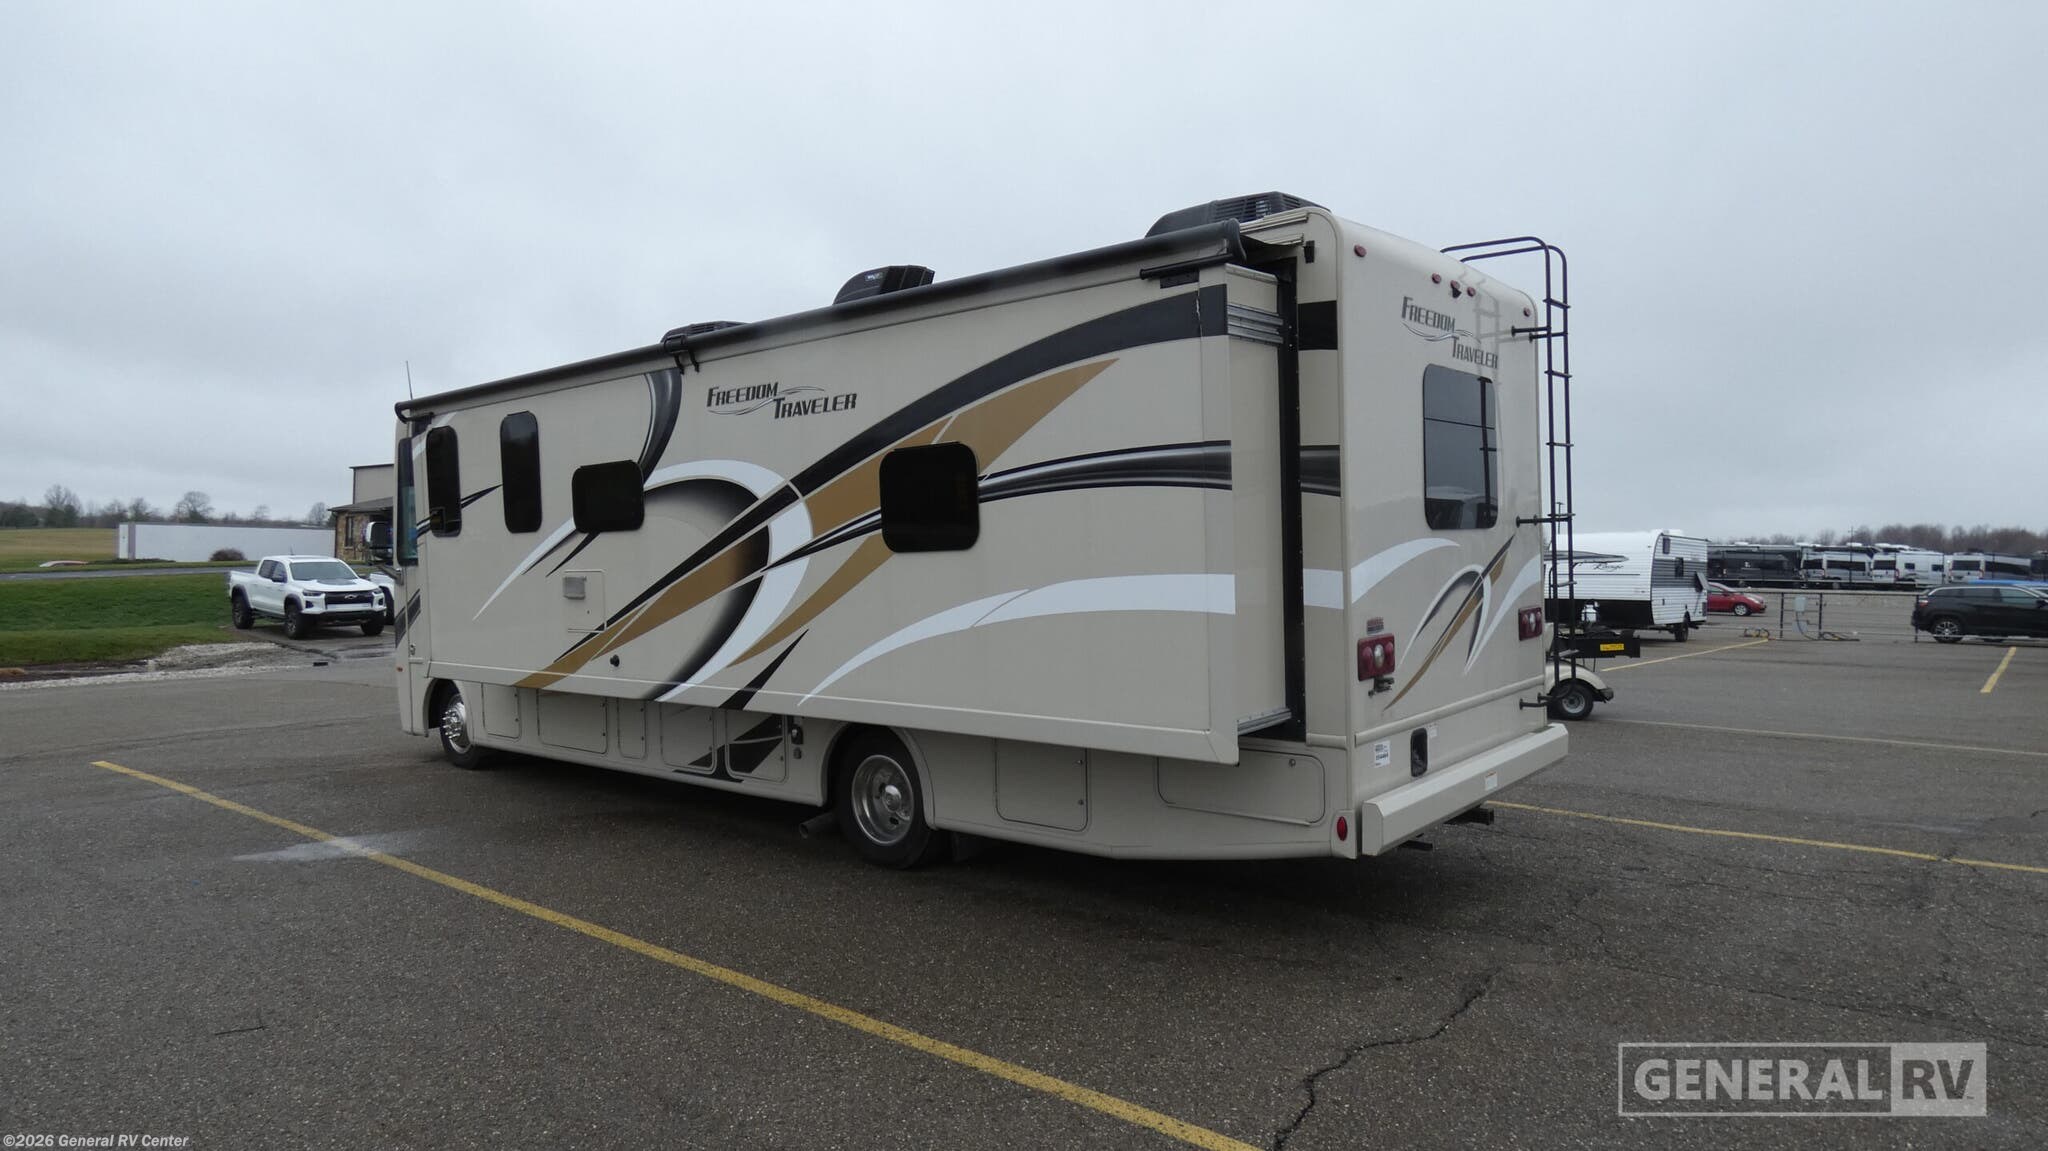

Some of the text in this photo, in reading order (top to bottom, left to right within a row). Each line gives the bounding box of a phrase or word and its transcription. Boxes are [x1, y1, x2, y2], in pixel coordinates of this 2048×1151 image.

[1401, 296, 1456, 332] FREEDOM
[1452, 336, 1499, 369] TRAVELER
[706, 381, 779, 408] FREEDOM
[773, 393, 858, 419] TRAVELER
